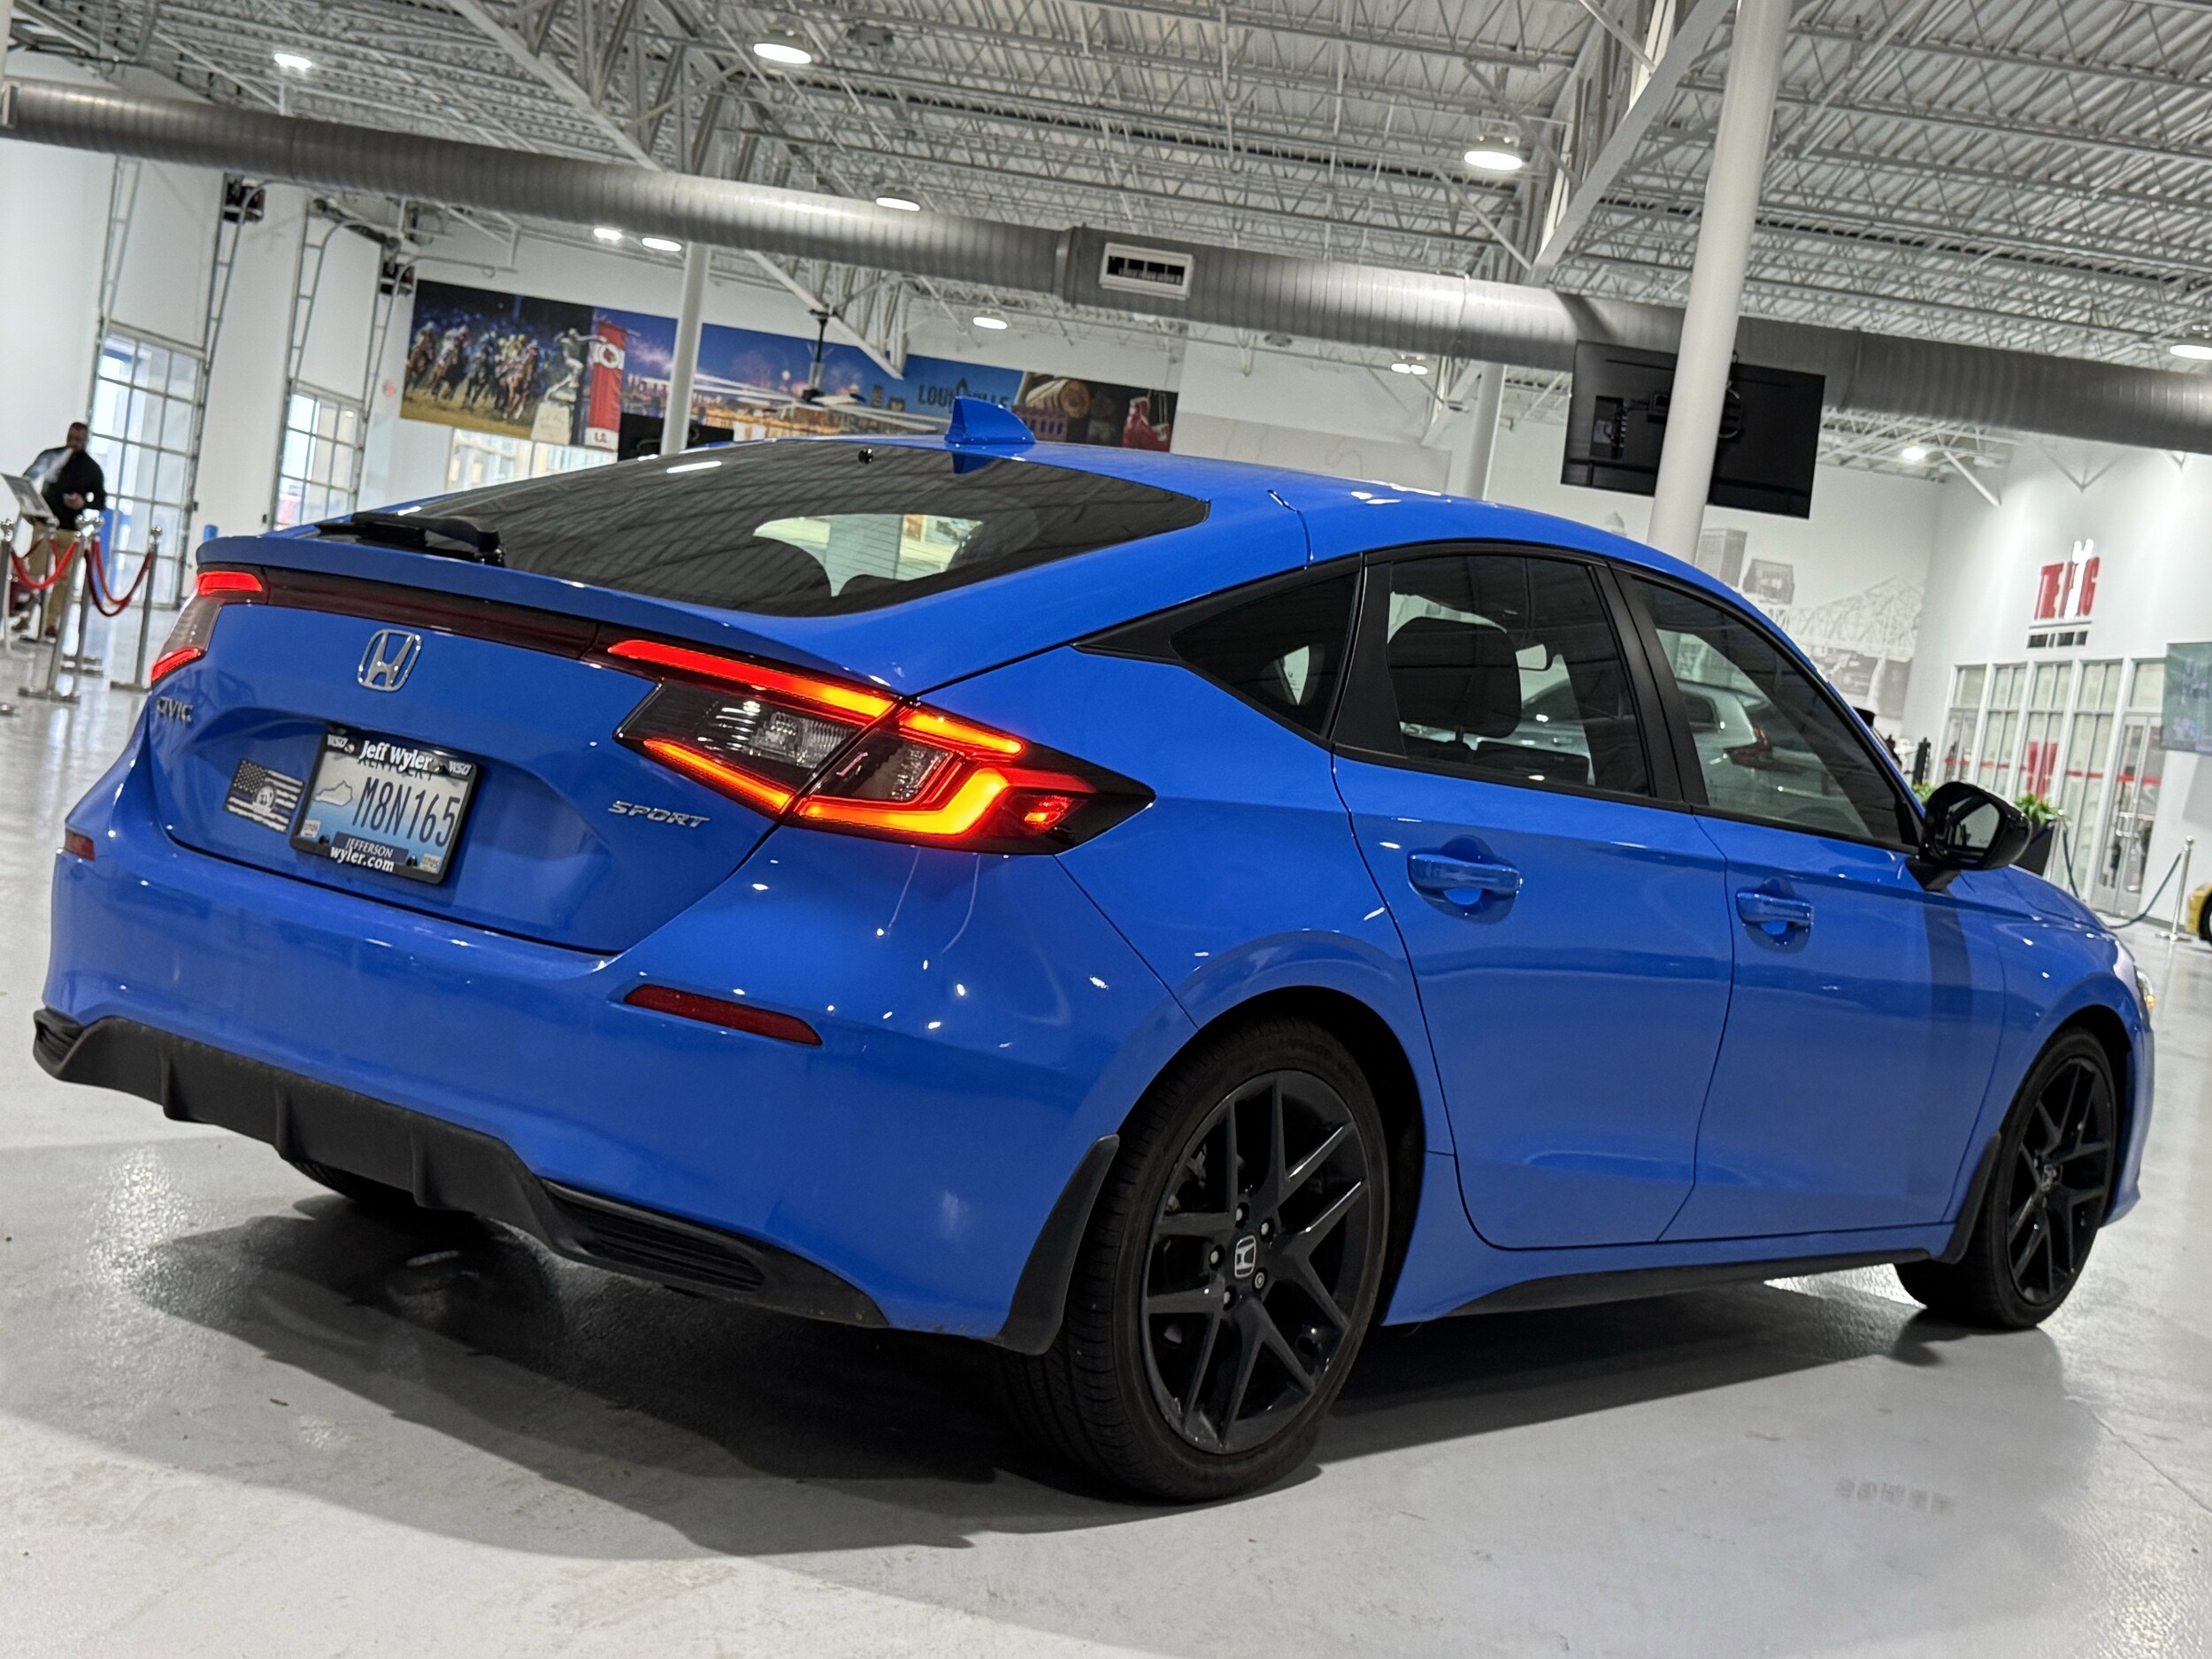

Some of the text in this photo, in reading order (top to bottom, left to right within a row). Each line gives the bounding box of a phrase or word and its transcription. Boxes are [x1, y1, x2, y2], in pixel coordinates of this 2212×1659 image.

[157, 695, 193, 722] CIVIC
[358, 740, 391, 761] Jeff
[389, 746, 433, 772] Wyler
[352, 776, 461, 847] M8N165
[608, 800, 710, 827] SPORT
[330, 846, 395, 872] wyler.com
[344, 837, 395, 858] JEFFERSON
